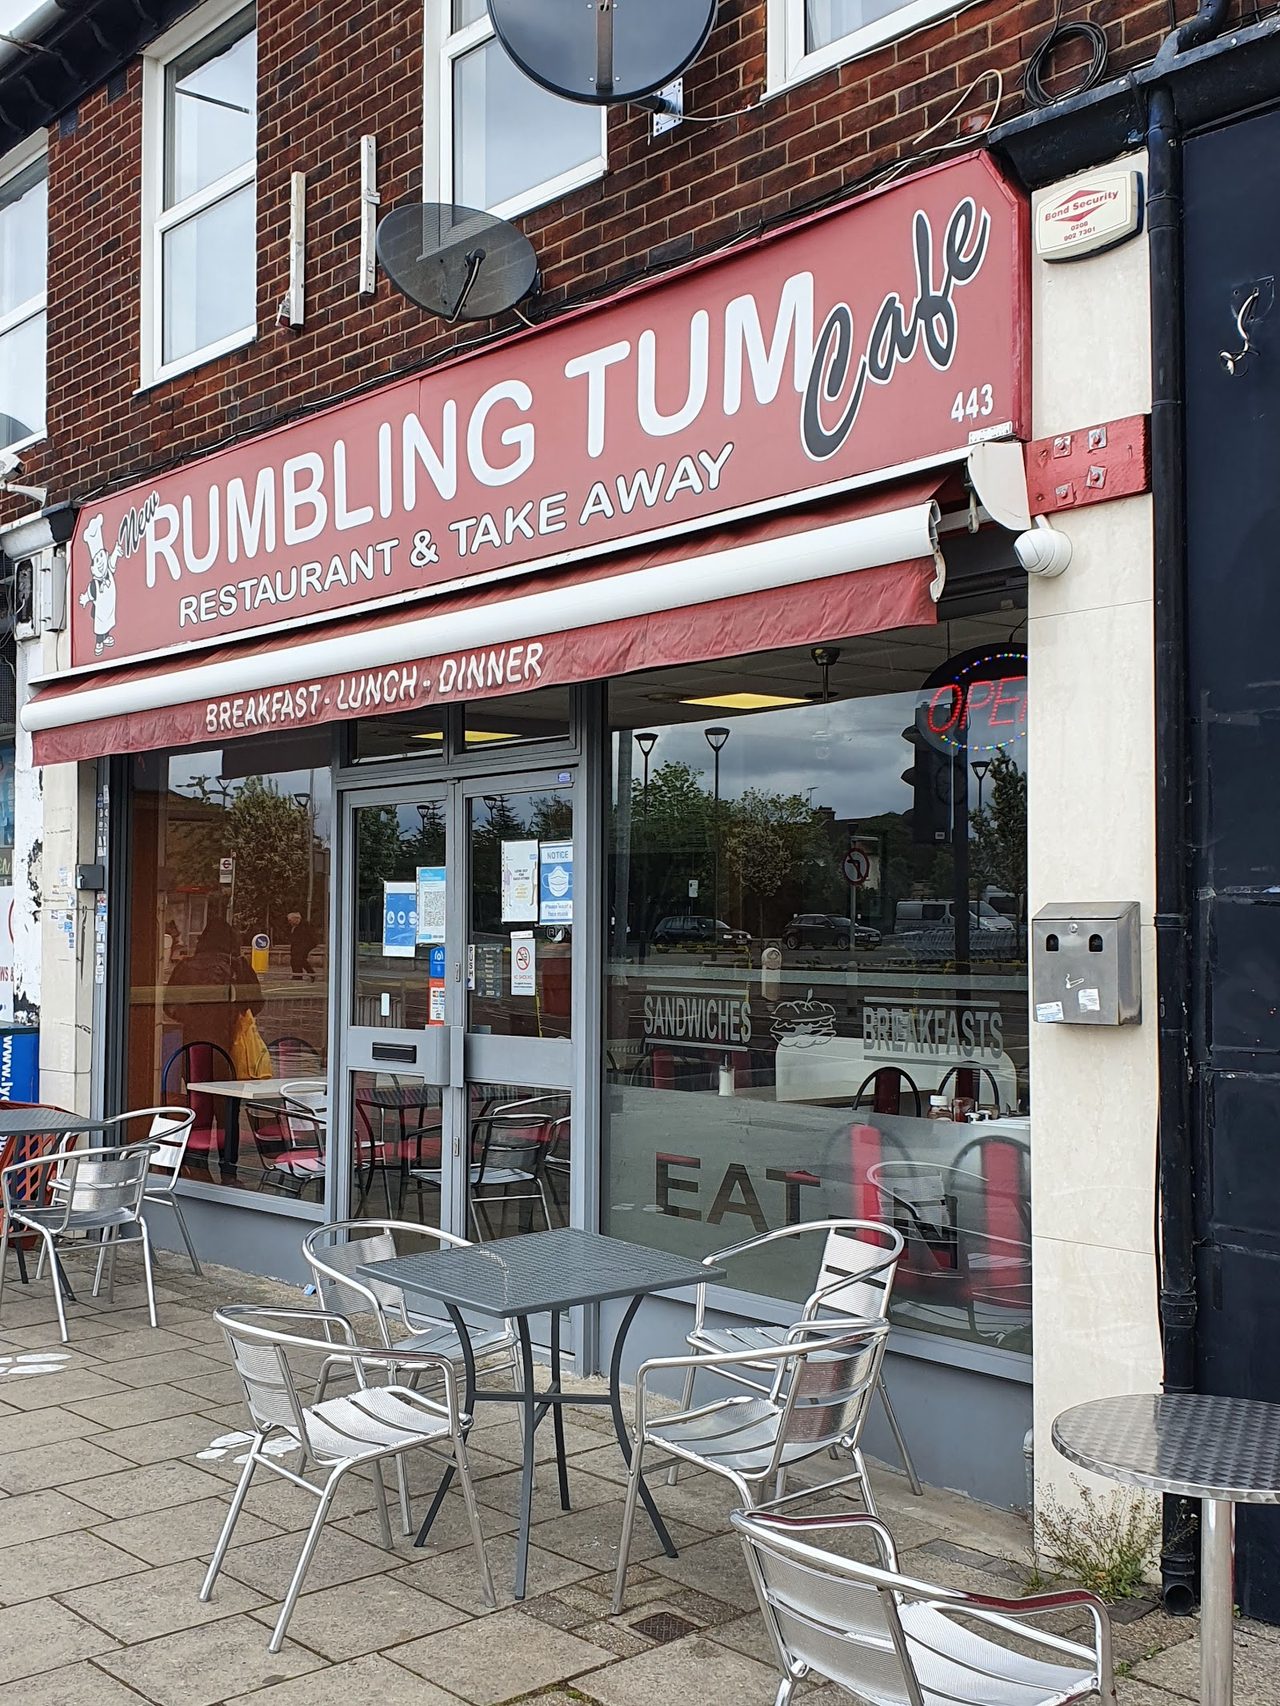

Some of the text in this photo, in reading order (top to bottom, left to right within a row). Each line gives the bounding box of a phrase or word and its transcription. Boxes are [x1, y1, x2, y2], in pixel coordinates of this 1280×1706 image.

[1044, 190, 1120, 222] Bond Security
[1070, 221, 1089, 232] 0208
[801, 196, 991, 462] Cafe
[144, 271, 815, 588] RUMBLING TUM
[951, 383, 995, 423] 443
[118, 490, 160, 559] New
[179, 441, 735, 628] RESTAURANT & TAKE AWAY
[204, 684, 321, 733] BREAKFAST
[336, 665, 417, 711] LUNCH
[437, 641, 544, 695] DINNER
[546, 850, 569, 860] NOTICE
[644, 995, 751, 1044] SANDWICHES
[863, 1006, 1003, 1060] BREAKFASTS
